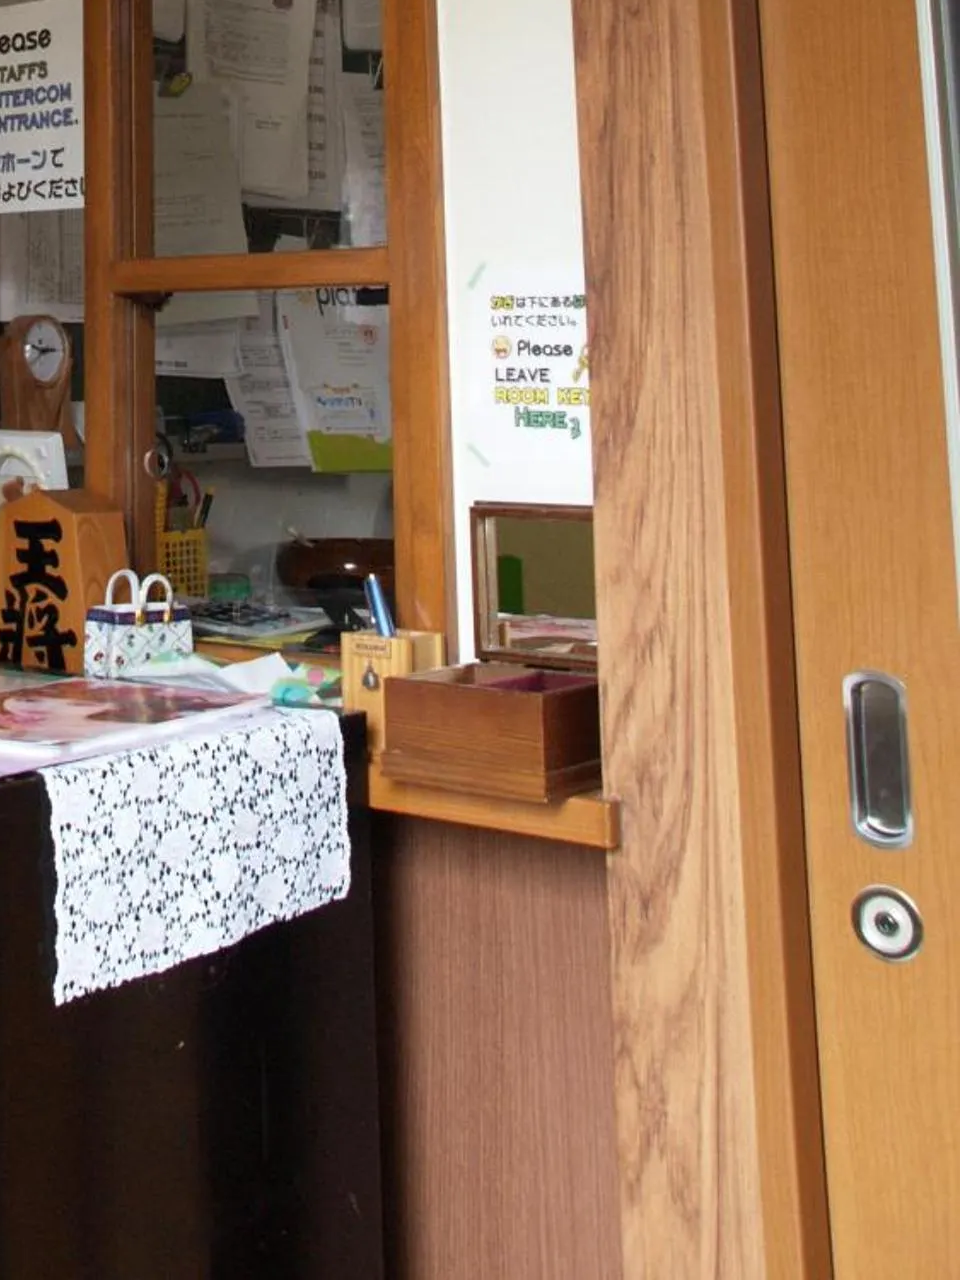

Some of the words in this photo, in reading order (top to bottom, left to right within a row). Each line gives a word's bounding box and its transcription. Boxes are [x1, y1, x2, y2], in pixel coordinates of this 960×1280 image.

[517, 339, 573, 356] Please
[495, 368, 550, 382] LEAVE
[494, 387, 549, 405] ROOM
[514, 406, 568, 429] HERE
